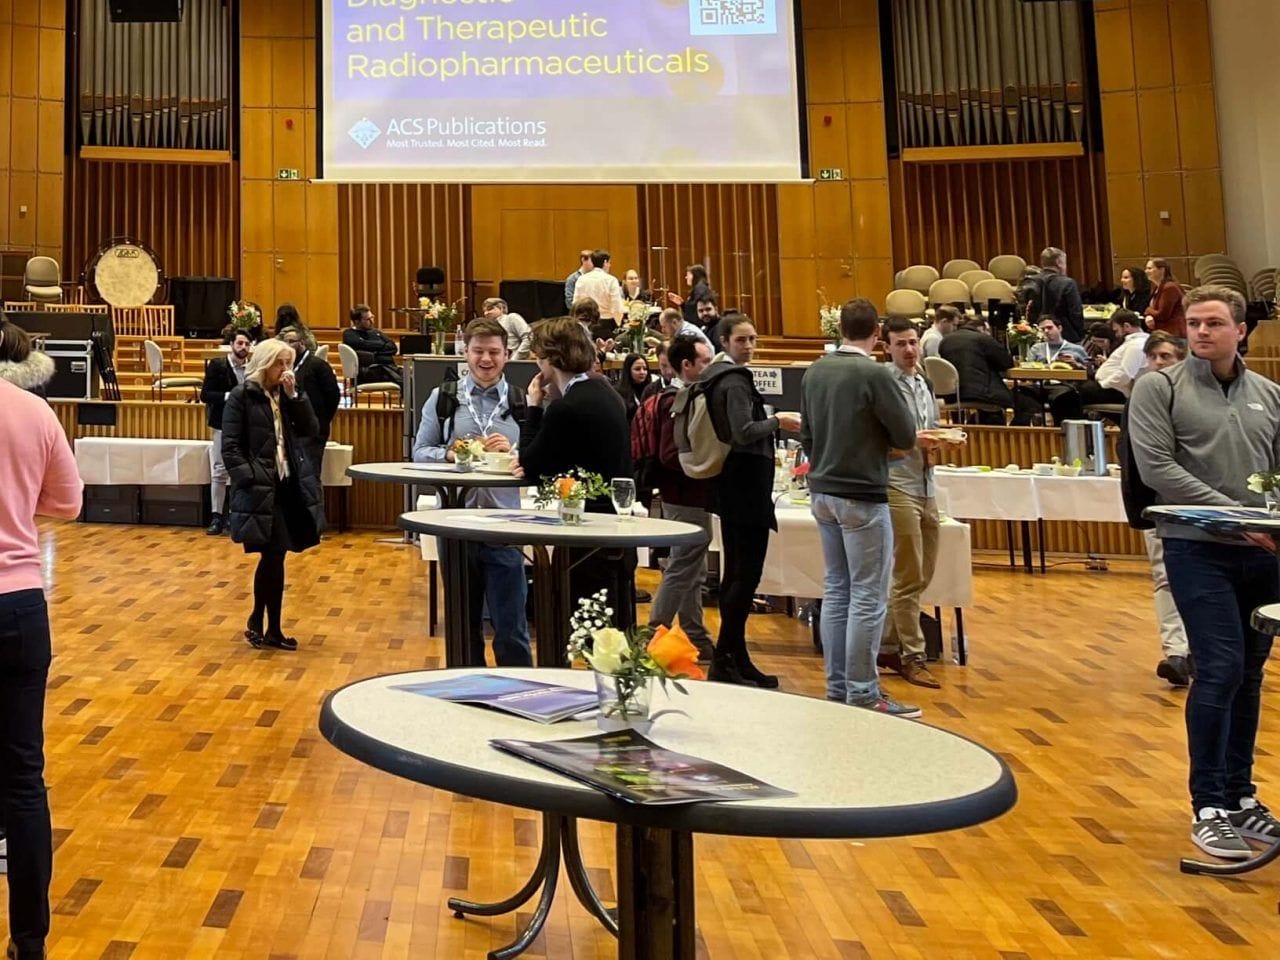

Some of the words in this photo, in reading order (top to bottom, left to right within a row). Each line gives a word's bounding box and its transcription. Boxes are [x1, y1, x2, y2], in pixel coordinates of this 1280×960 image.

[346, 16, 405, 42] and
[416, 12, 608, 43] Therapeutic
[347, 47, 710, 81] Radiopharmaceuticals
[387, 118, 424, 136] ACS
[427, 116, 547, 136] Publications
[387, 139, 408, 147] Most
[411, 139, 445, 148] Trusted.
[447, 139, 469, 147] Most
[471, 138, 496, 147] Cited.
[498, 138, 521, 147] Most
[523, 138, 546, 147] Read.
